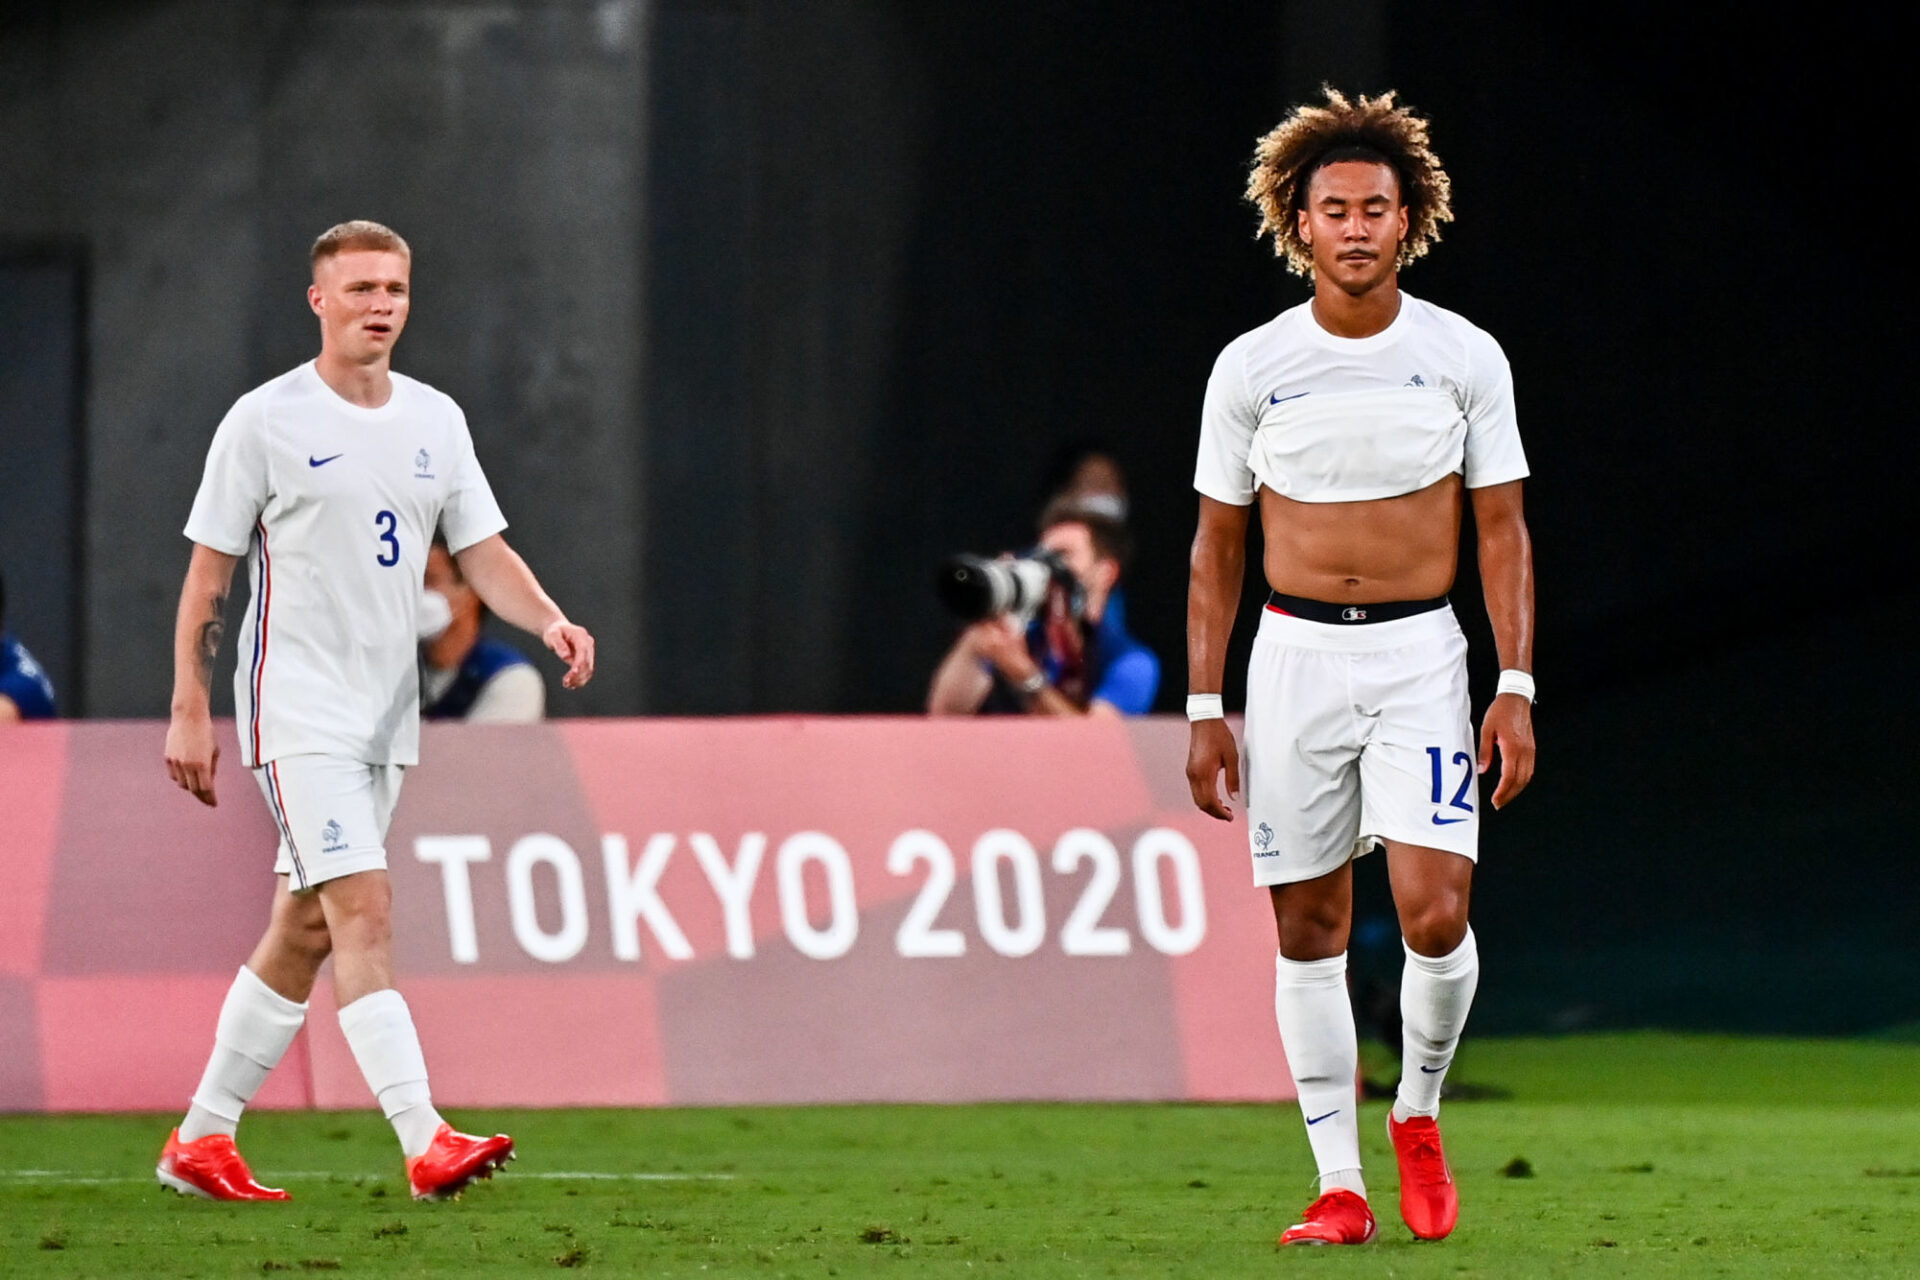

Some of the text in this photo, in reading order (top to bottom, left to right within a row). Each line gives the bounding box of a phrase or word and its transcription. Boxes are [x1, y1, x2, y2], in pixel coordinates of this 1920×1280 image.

[375, 509, 400, 567] 3
[1425, 746, 1474, 814] 12
[1253, 850, 1280, 858] FRANCE
[413, 827, 1208, 964] TOKYO 2020
